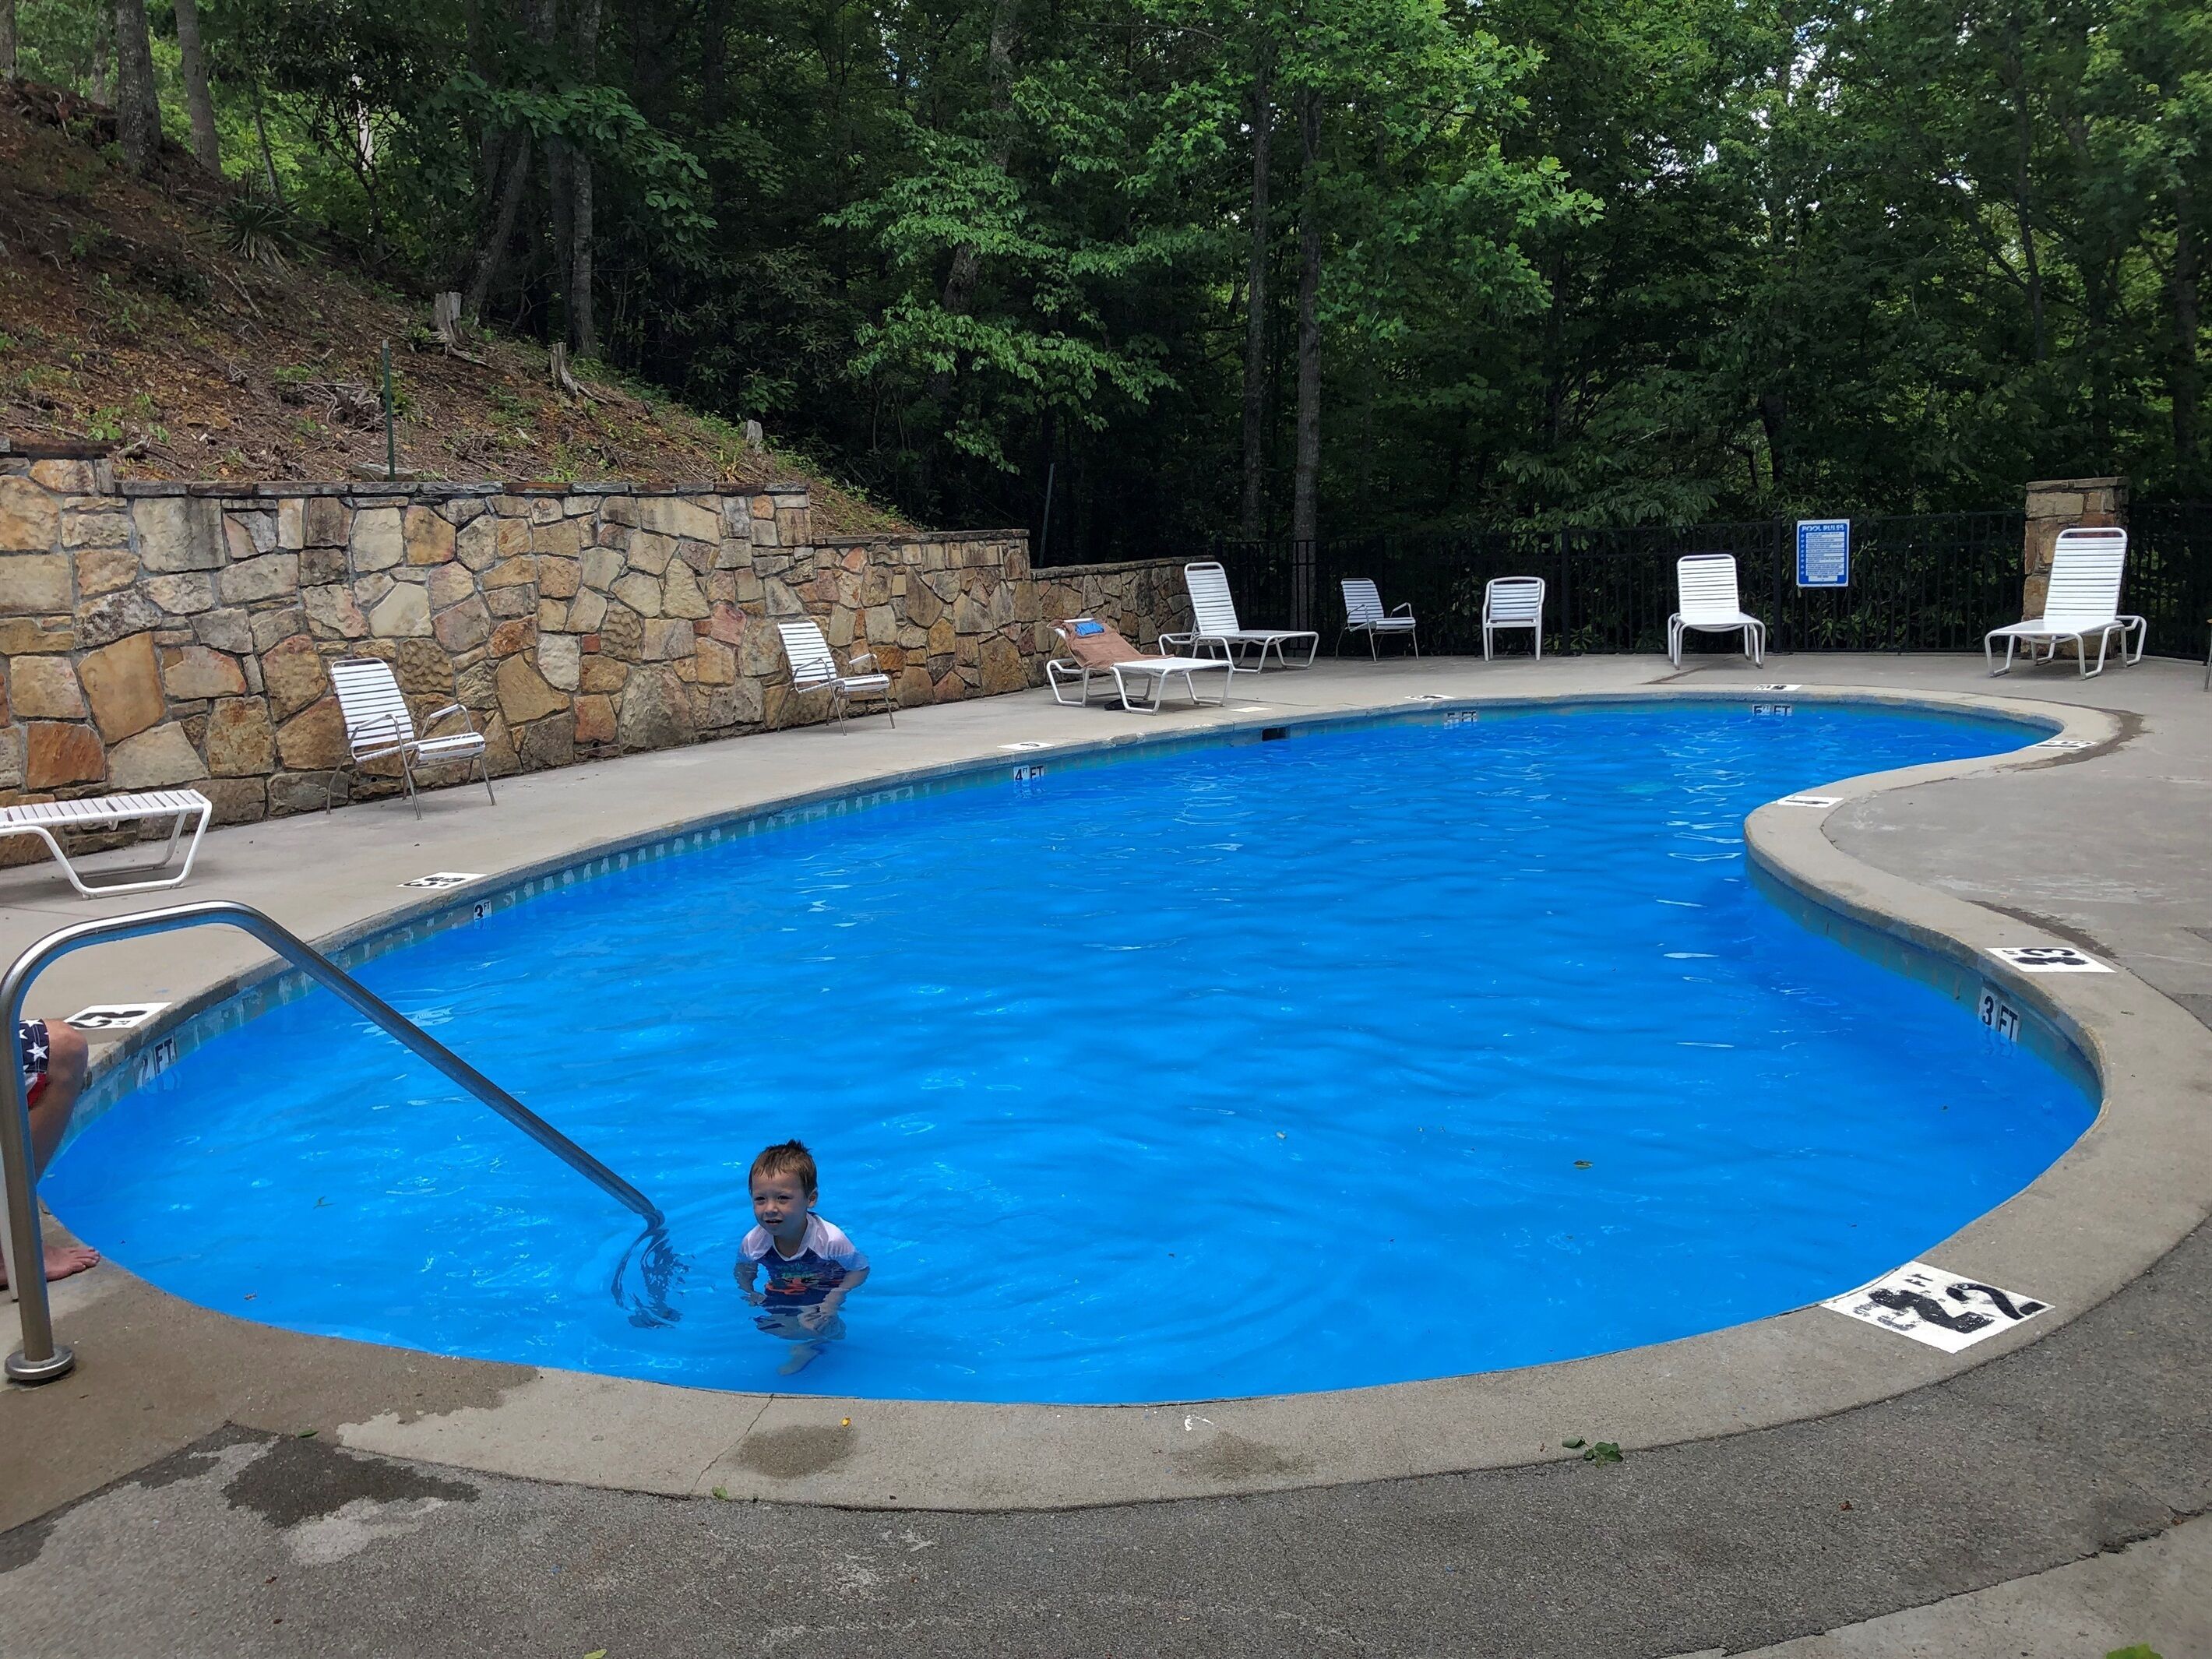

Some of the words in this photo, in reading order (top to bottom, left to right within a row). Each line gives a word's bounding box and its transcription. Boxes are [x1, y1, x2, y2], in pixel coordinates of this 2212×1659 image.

[1773, 705, 1791, 716] FT
[1015, 768, 1023, 780] 4
[1030, 765, 1044, 779] FT
[474, 903, 484, 919] 3
[1981, 995, 1995, 1027] 3
[1998, 1004, 2019, 1041] FT
[154, 1037, 173, 1074] FT
[1946, 1283, 2047, 1321] 2
